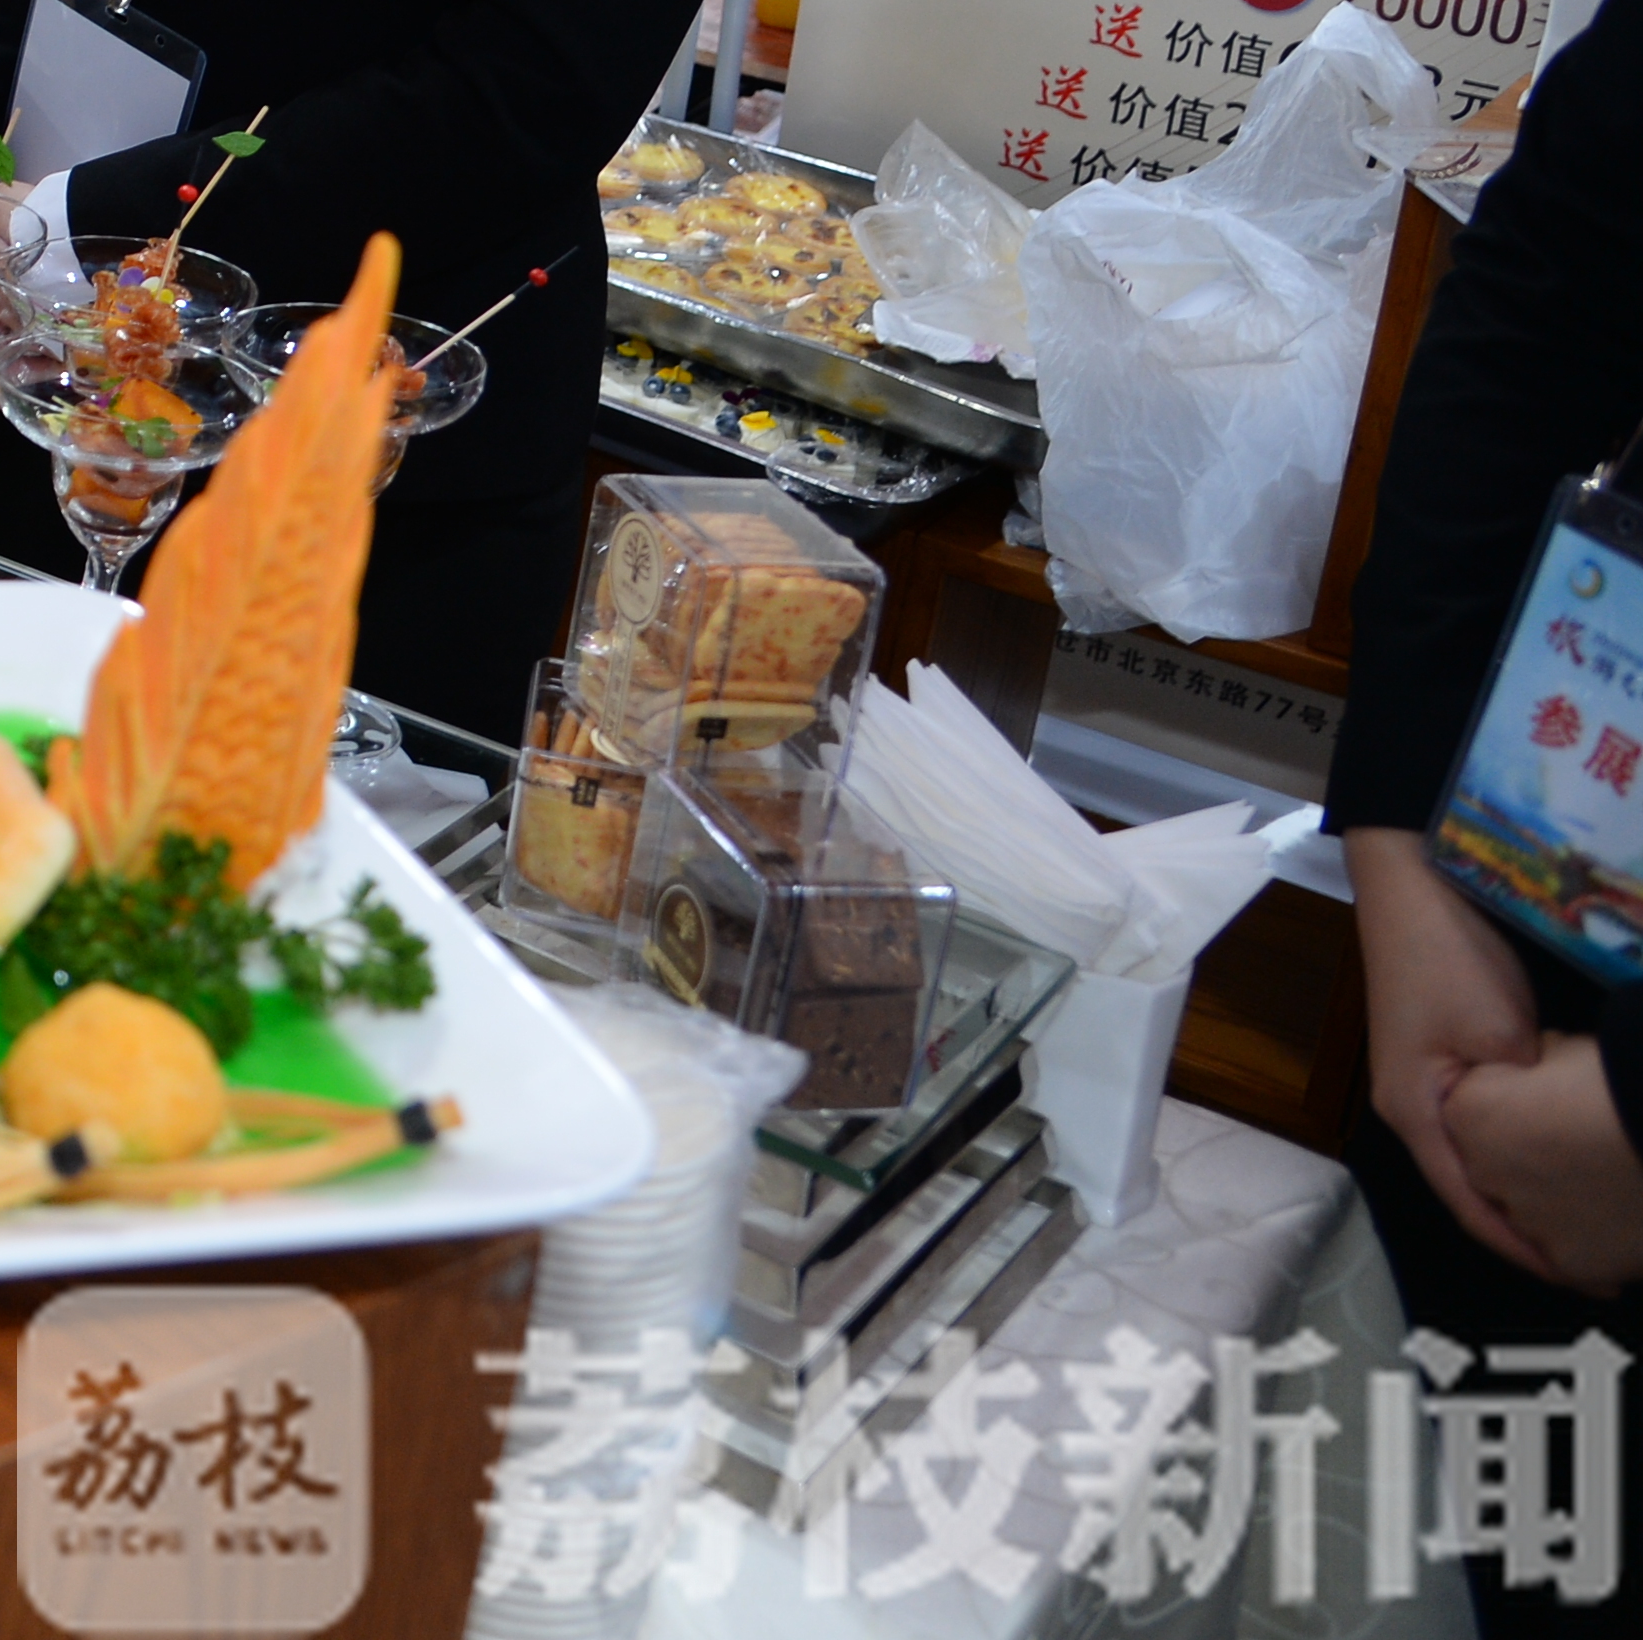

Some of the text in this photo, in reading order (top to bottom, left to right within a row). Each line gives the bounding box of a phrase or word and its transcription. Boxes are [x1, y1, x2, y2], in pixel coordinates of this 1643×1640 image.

[1090, 4, 1143, 59] 送
[1035, 65, 1089, 121] 送
[999, 128, 1050, 183] 送
[1055, 629, 1344, 740] 仓市北京东路77号
